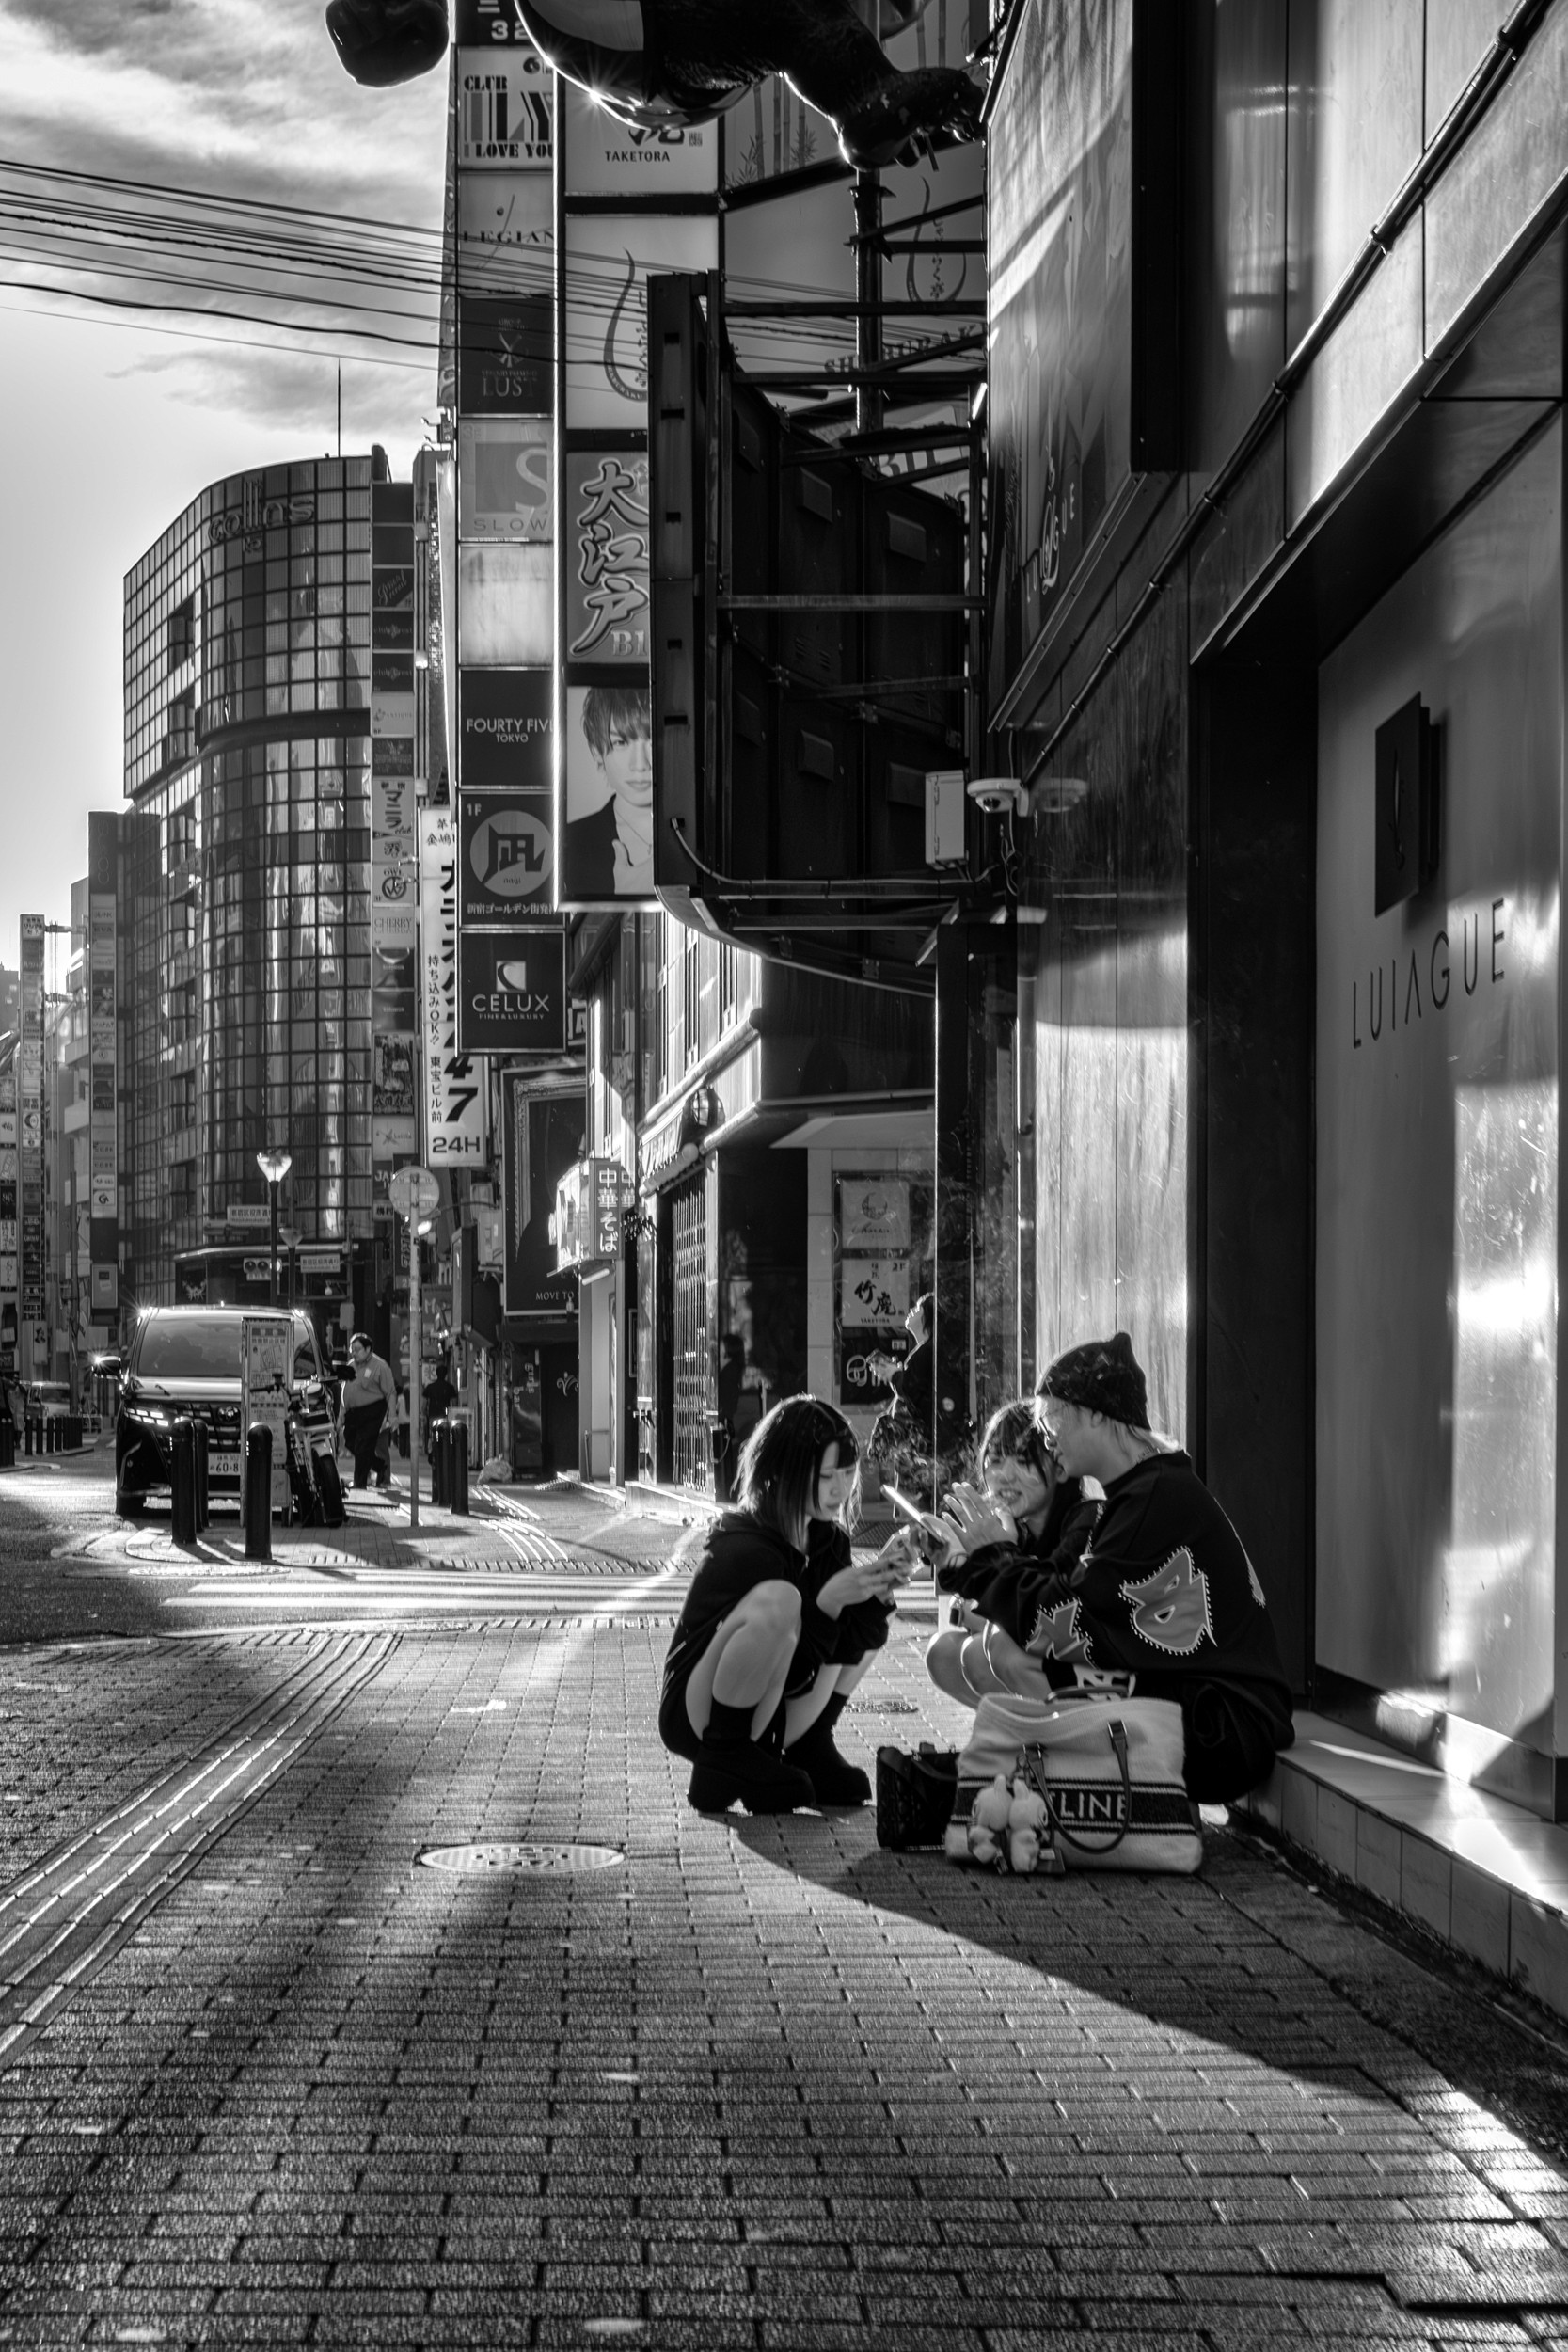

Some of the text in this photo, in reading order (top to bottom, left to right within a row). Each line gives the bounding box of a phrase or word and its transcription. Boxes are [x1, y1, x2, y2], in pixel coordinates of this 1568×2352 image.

[464, 75, 508, 91] CLUB
[464, 144, 470, 159] I
[475, 144, 519, 159] LOVE
[605, 151, 671, 162] TAKETORA
[473, 519, 547, 532] SLOW
[571, 458, 650, 656] 大江戸
[467, 718, 524, 732] FOURTY
[496, 734, 529, 743] TOKYO
[385, 790, 402, 828] マニラ
[467, 803, 482, 817] 1F
[1353, 898, 1505, 1049] LUIAGUE
[472, 994, 549, 1012] CELUX
[430, 1056, 443, 1123] 東宝ビル前
[432, 1136, 481, 1154] 24H
[597, 1167, 619, 1252] 中華そば
[535, 1291, 575, 1301] MOVE TO
[1049, 1790, 1128, 1821] LINE
